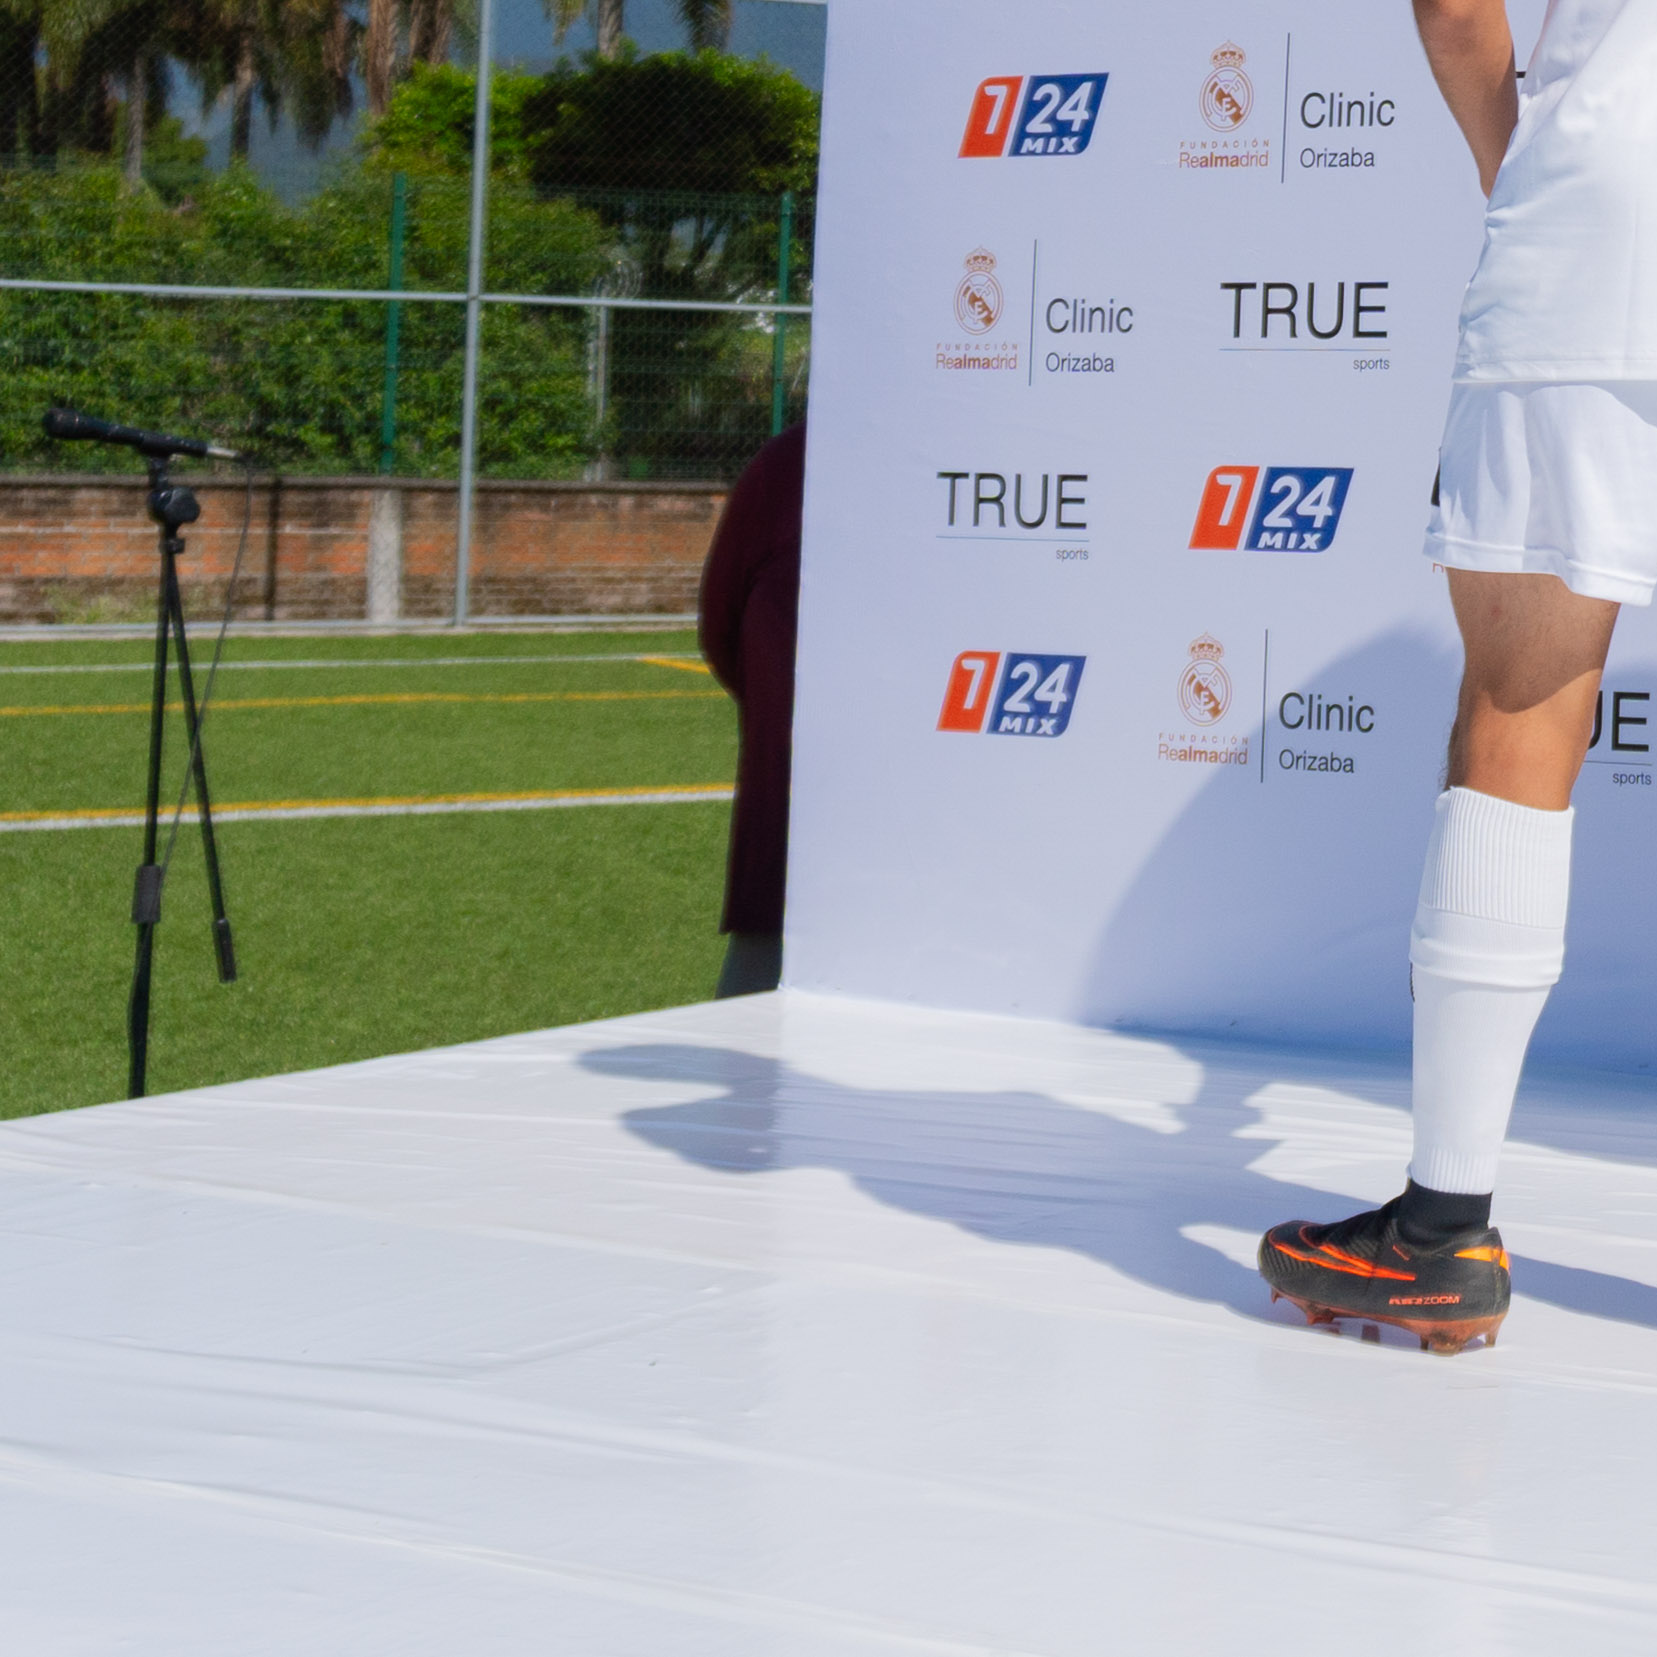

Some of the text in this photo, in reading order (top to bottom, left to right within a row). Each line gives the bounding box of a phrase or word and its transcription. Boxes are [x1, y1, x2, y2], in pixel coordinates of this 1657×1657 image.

[1025, 82, 1091, 133] 24
[1301, 92, 1395, 128] Clinic
[1020, 137, 1079, 154] MIX
[1180, 138, 1270, 149] FUNDACIÓN
[1179, 149, 1269, 169] Realmadrid
[1300, 147, 1375, 168] Orizaba
[1046, 298, 1133, 333] Clinic
[1221, 282, 1388, 339] TRUE
[936, 353, 1017, 370] Realmadrid
[1046, 352, 1114, 372] Orizaba
[1353, 358, 1390, 372] sports
[937, 472, 1088, 529] TRUE
[1263, 476, 1334, 528] 24
[1257, 533, 1320, 550] MIX
[1056, 549, 1089, 562] sports
[1004, 662, 1069, 713] 24
[1280, 692, 1374, 733] Clinic
[999, 716, 1059, 735] MIX
[1159, 733, 1248, 745] FUNDACIÓN
[1158, 745, 1247, 765] Realmadrid
[1279, 749, 1354, 773] Orizaba
[1613, 772, 1652, 786] sports
